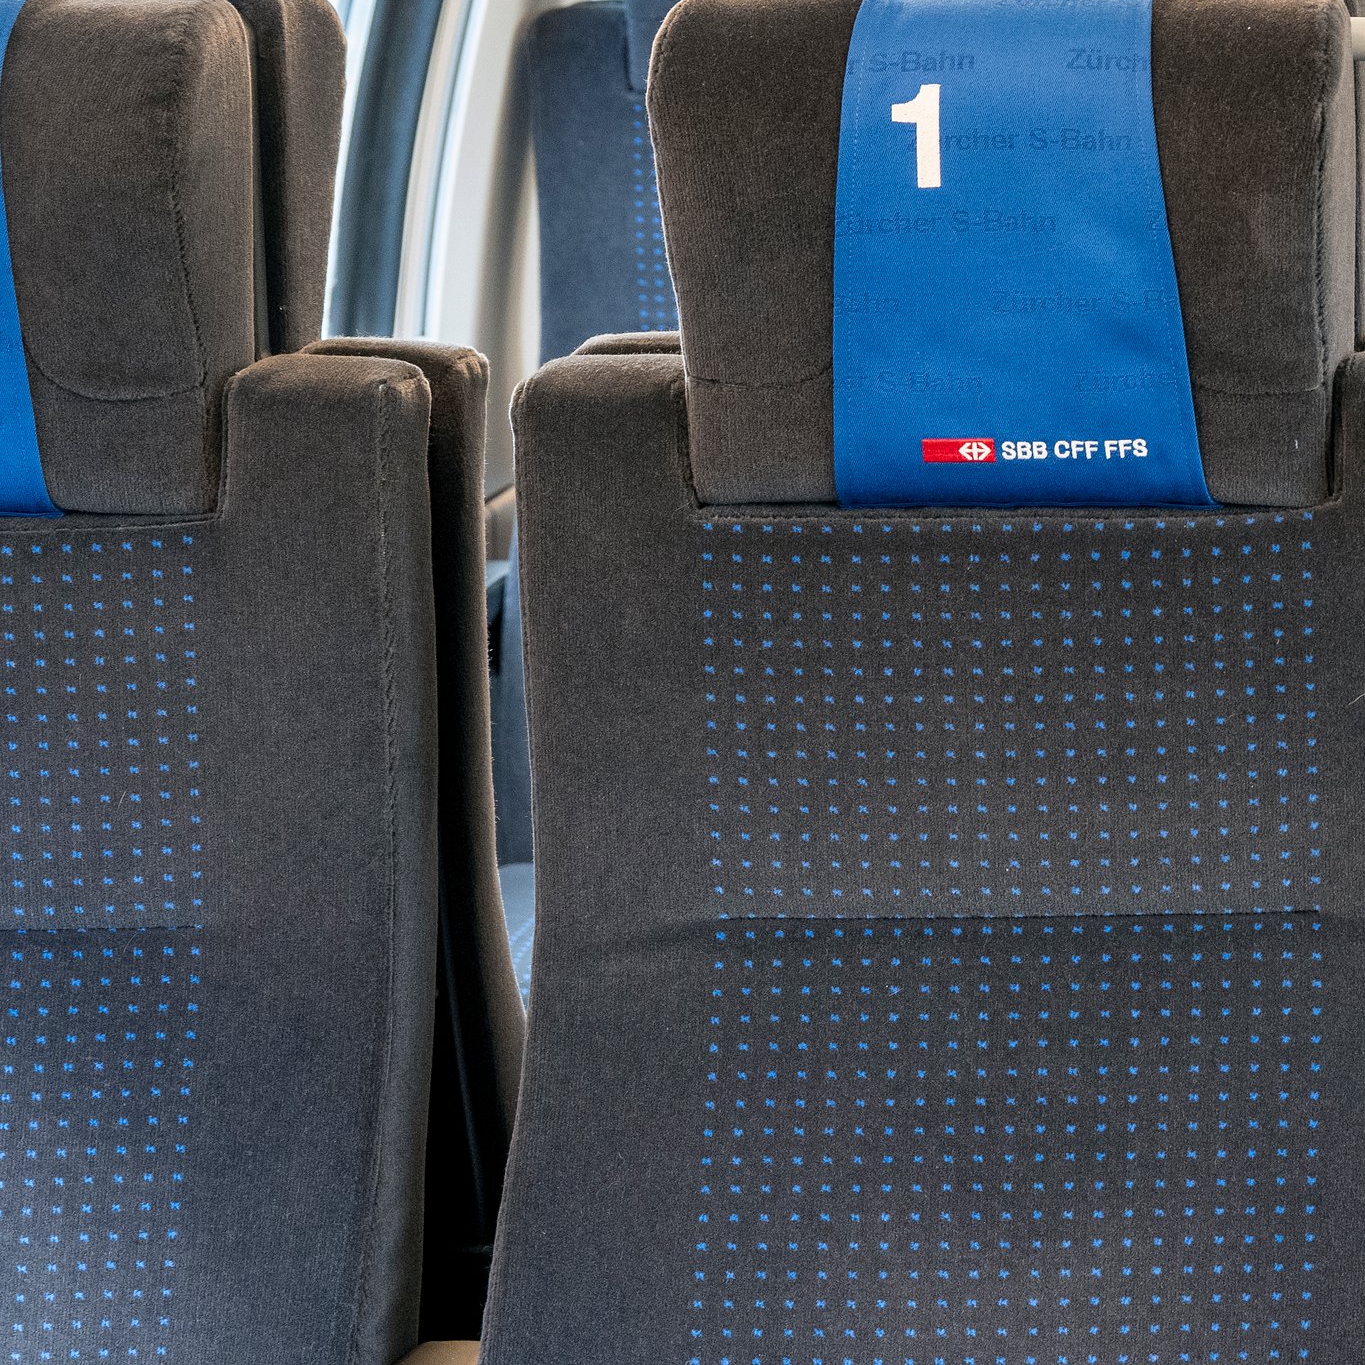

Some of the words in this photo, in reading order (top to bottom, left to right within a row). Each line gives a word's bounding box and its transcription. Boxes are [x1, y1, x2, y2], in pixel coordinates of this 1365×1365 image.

[891, 84, 941, 189] 1
[1002, 441, 1048, 460] SBB
[1054, 440, 1098, 459] CFF
[1104, 438, 1148, 459] FFS
